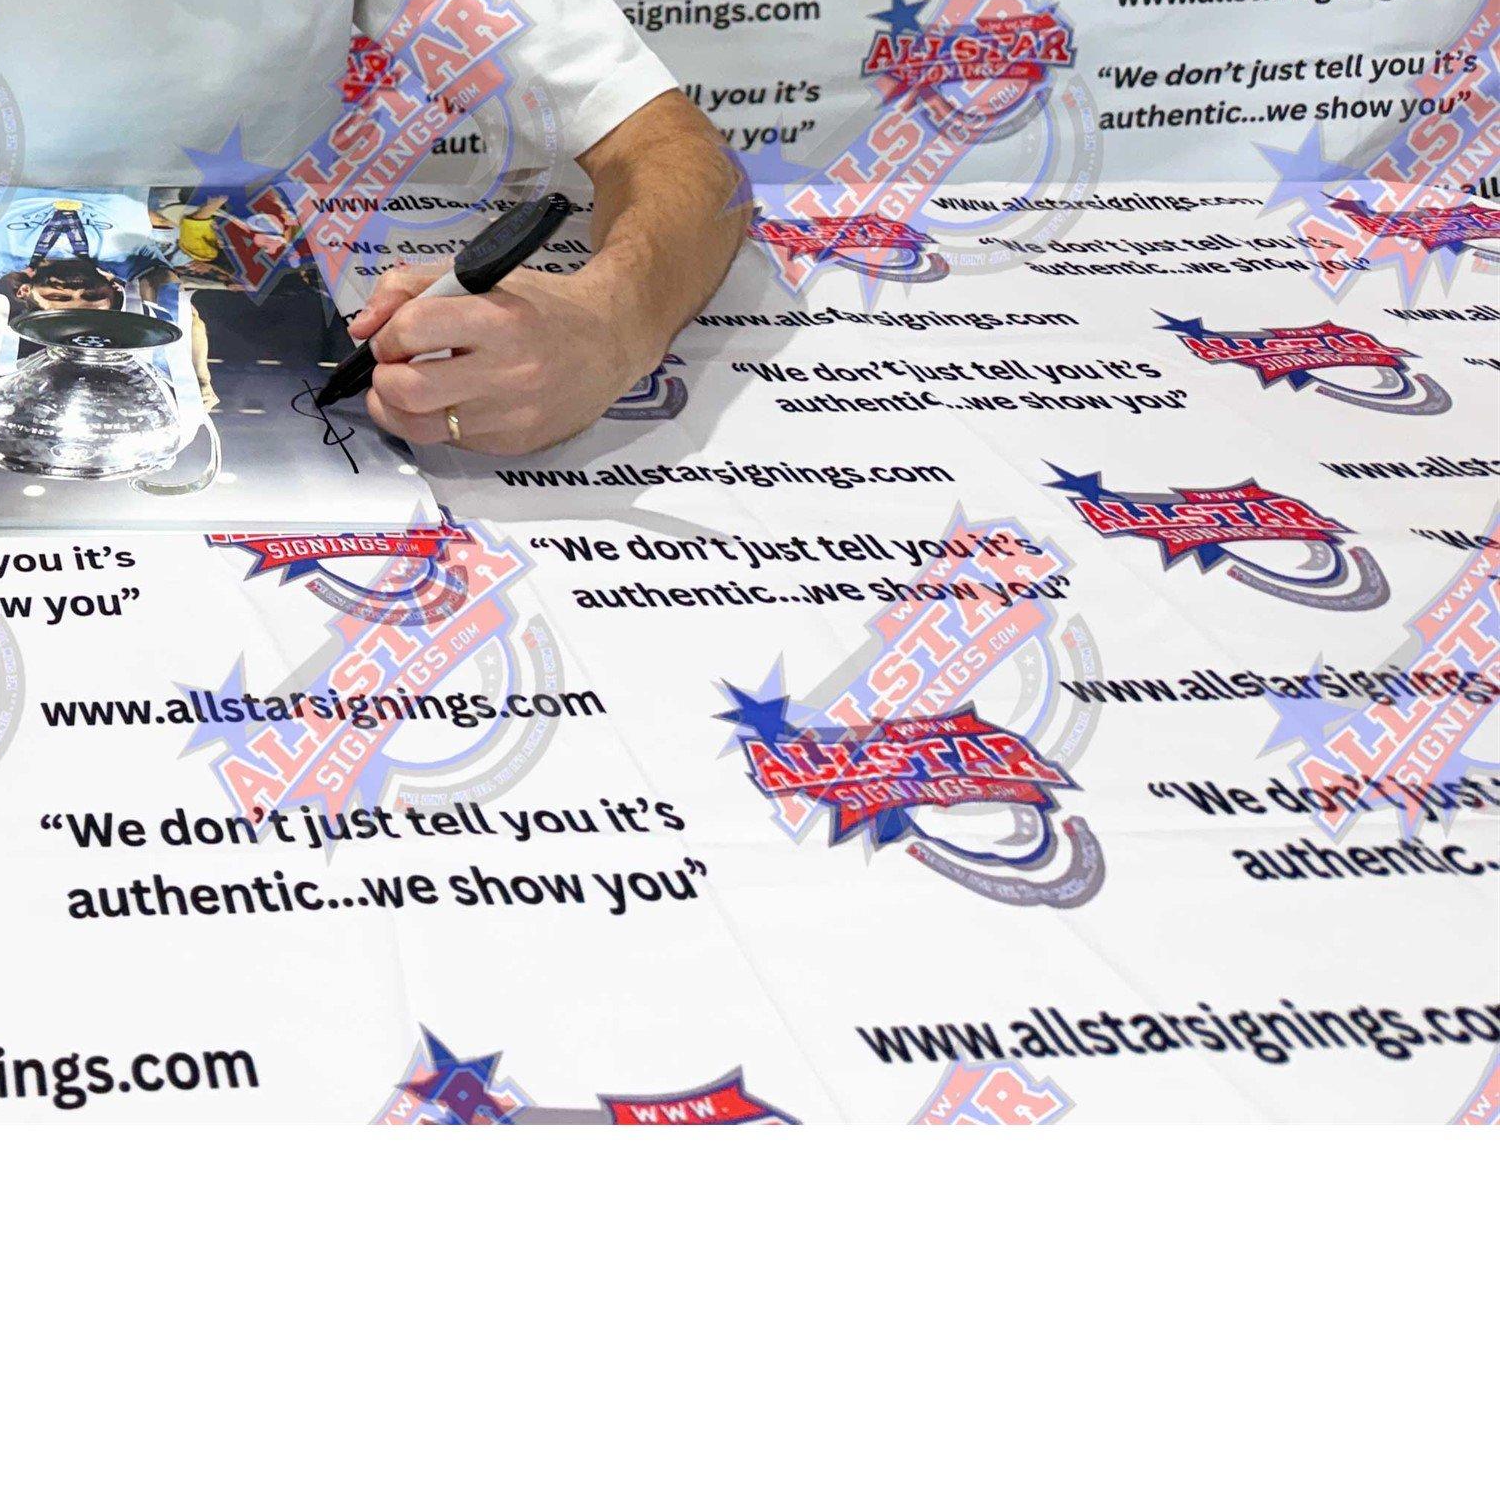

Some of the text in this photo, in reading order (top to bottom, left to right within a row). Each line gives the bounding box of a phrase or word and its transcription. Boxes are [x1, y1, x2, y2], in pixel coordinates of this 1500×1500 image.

[1246, 59, 1308, 89] just
[1314, 53, 1364, 80] tell
[1368, 57, 1425, 84] you
[1314, 95, 1394, 120] show
[695, 306, 1081, 332] www.allstarsignings.com
[494, 462, 957, 489] www.allstarsignings.com
[1073, 497, 1352, 534] ALLSTAR
[40, 687, 607, 730] www.allstarsignings.com
[745, 732, 1076, 792] ALLSTAR
[300, 805, 402, 849] just
[405, 802, 498, 836] tell
[499, 809, 600, 842] you
[448, 865, 585, 906] show
[855, 999, 1500, 1065] www.allstarsignings.co
